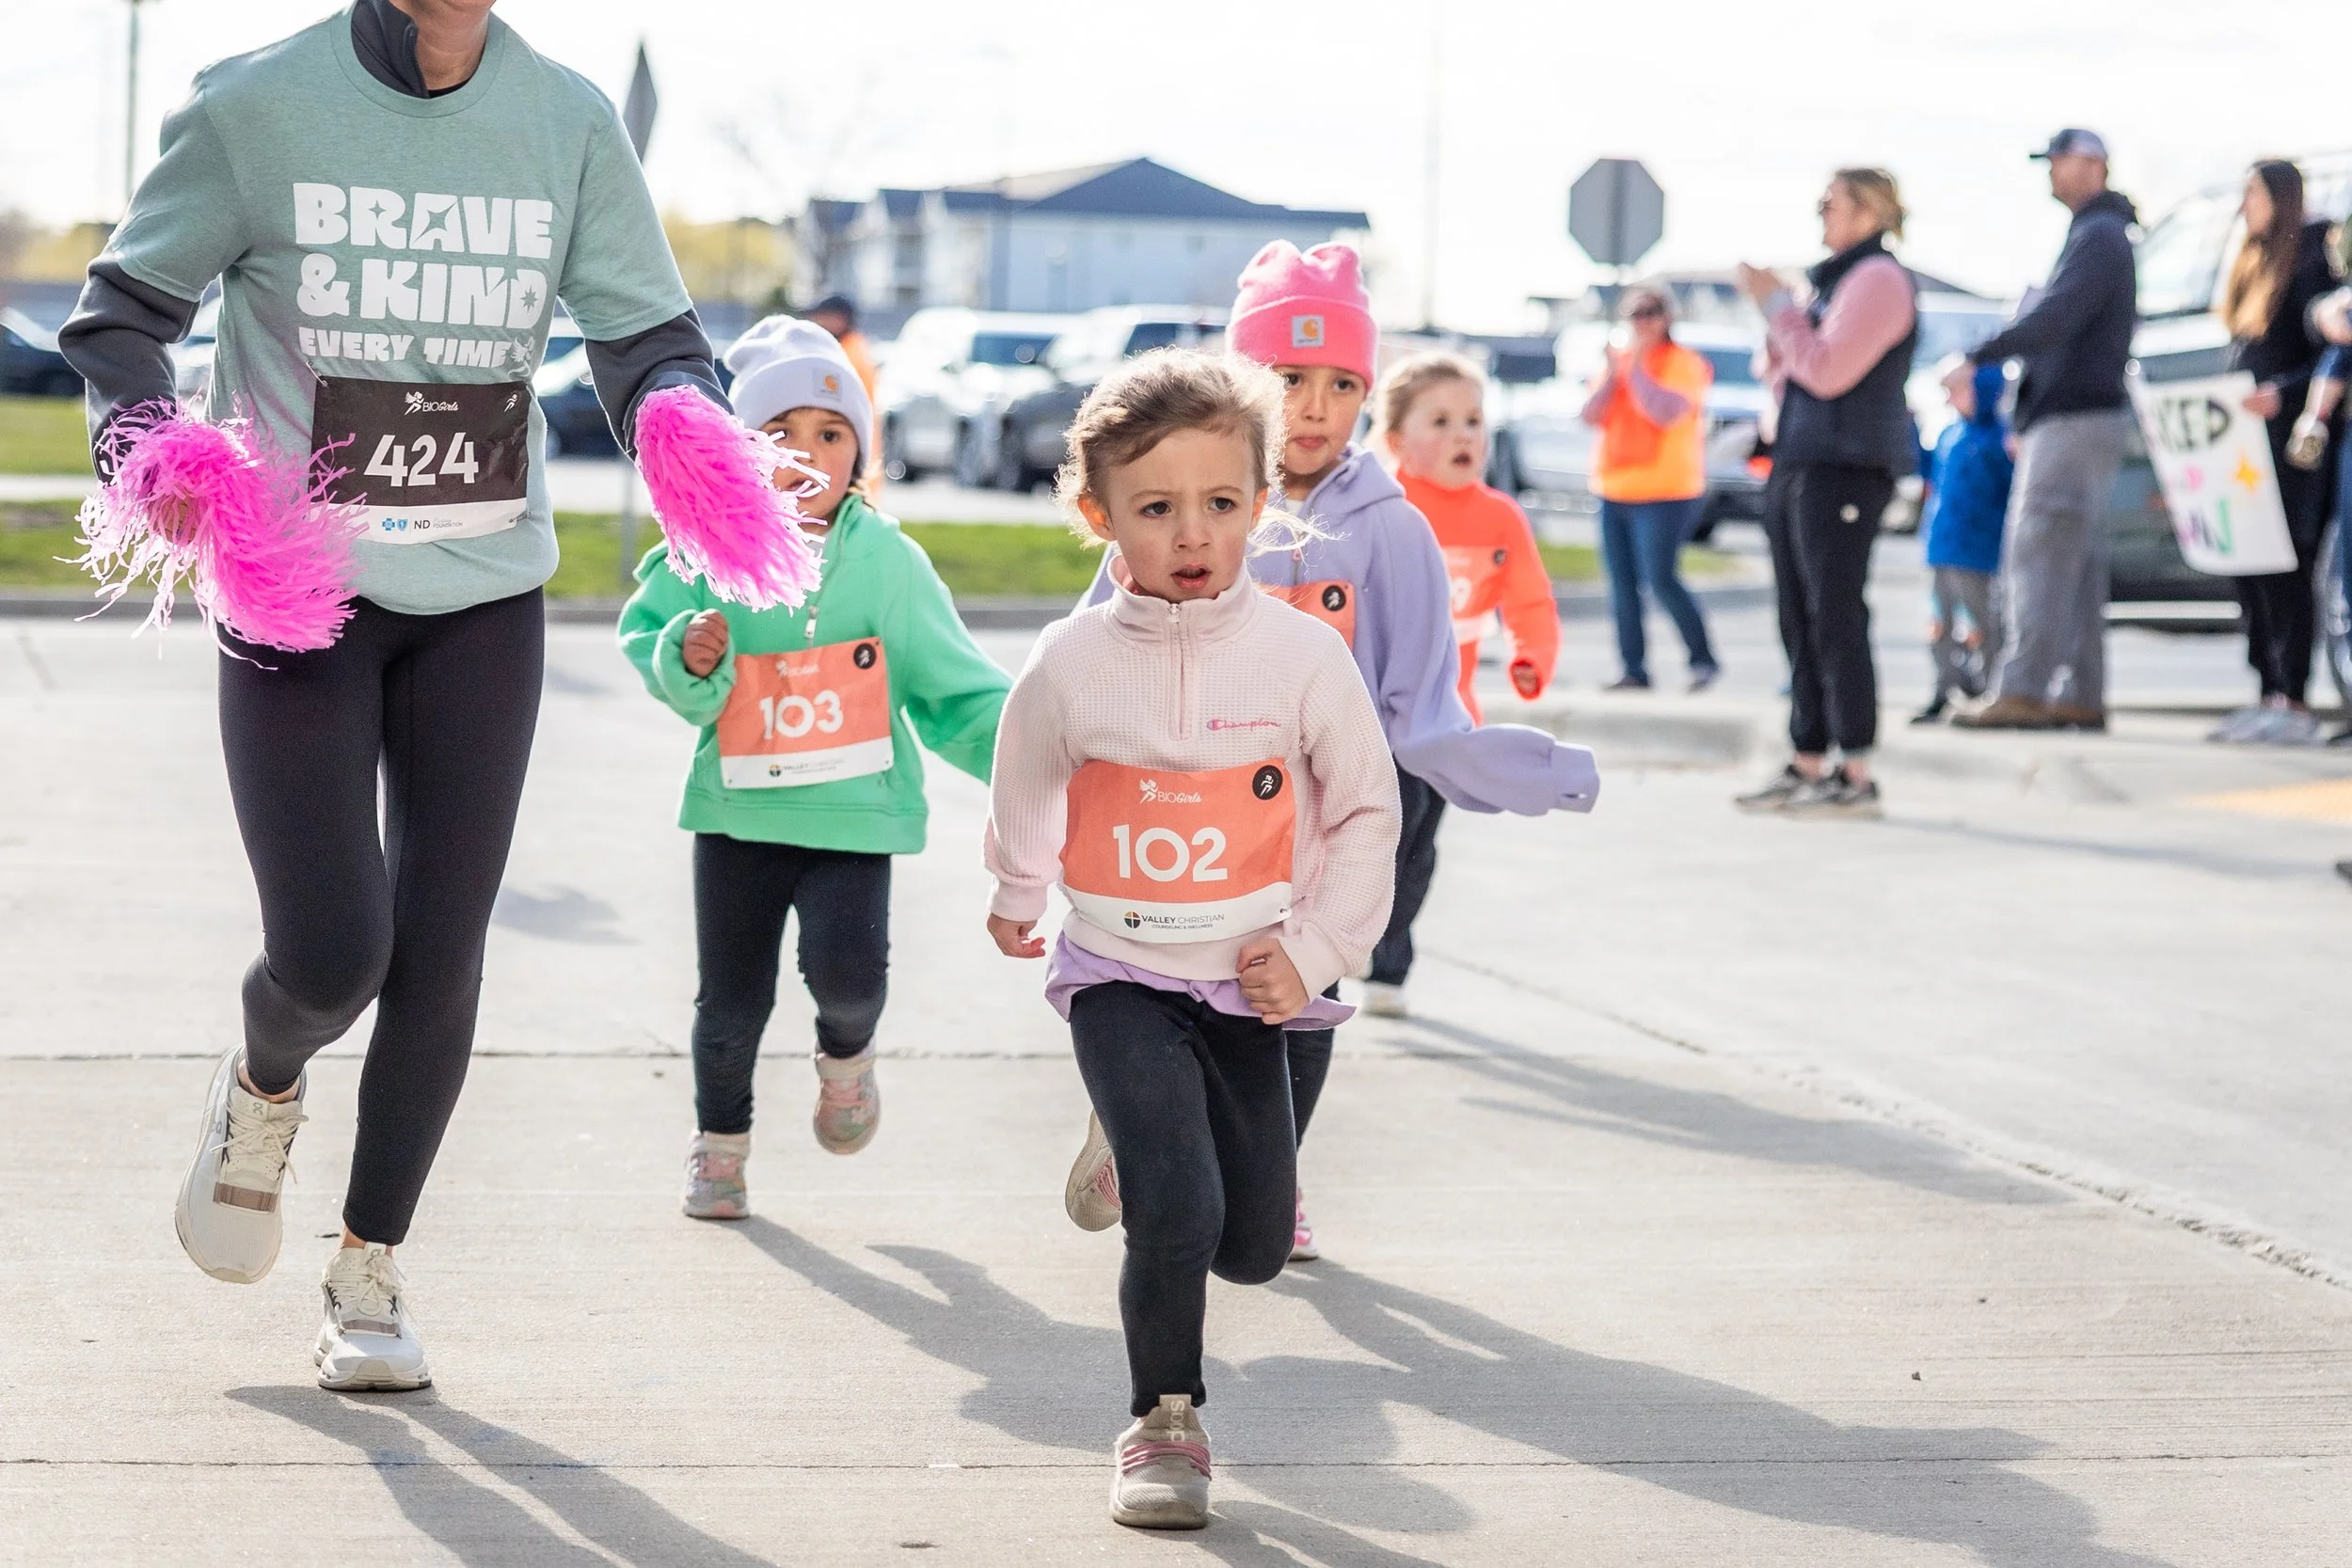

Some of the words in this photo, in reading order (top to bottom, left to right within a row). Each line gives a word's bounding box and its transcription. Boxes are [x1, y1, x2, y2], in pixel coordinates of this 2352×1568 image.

[293, 182, 553, 260] BRAVE
[296, 253, 350, 317] &
[360, 259, 548, 329] KIND
[298, 326, 415, 362] EVERY
[423, 338, 514, 369] TIME
[363, 432, 480, 487] 424
[414, 519, 431, 530] ND
[758, 689, 844, 740] 103
[1206, 718, 1281, 732] Champion
[1112, 824, 1229, 882] 102
[1141, 914, 1176, 924] VALLEY
[1177, 913, 1225, 924] CHRISTIAN
